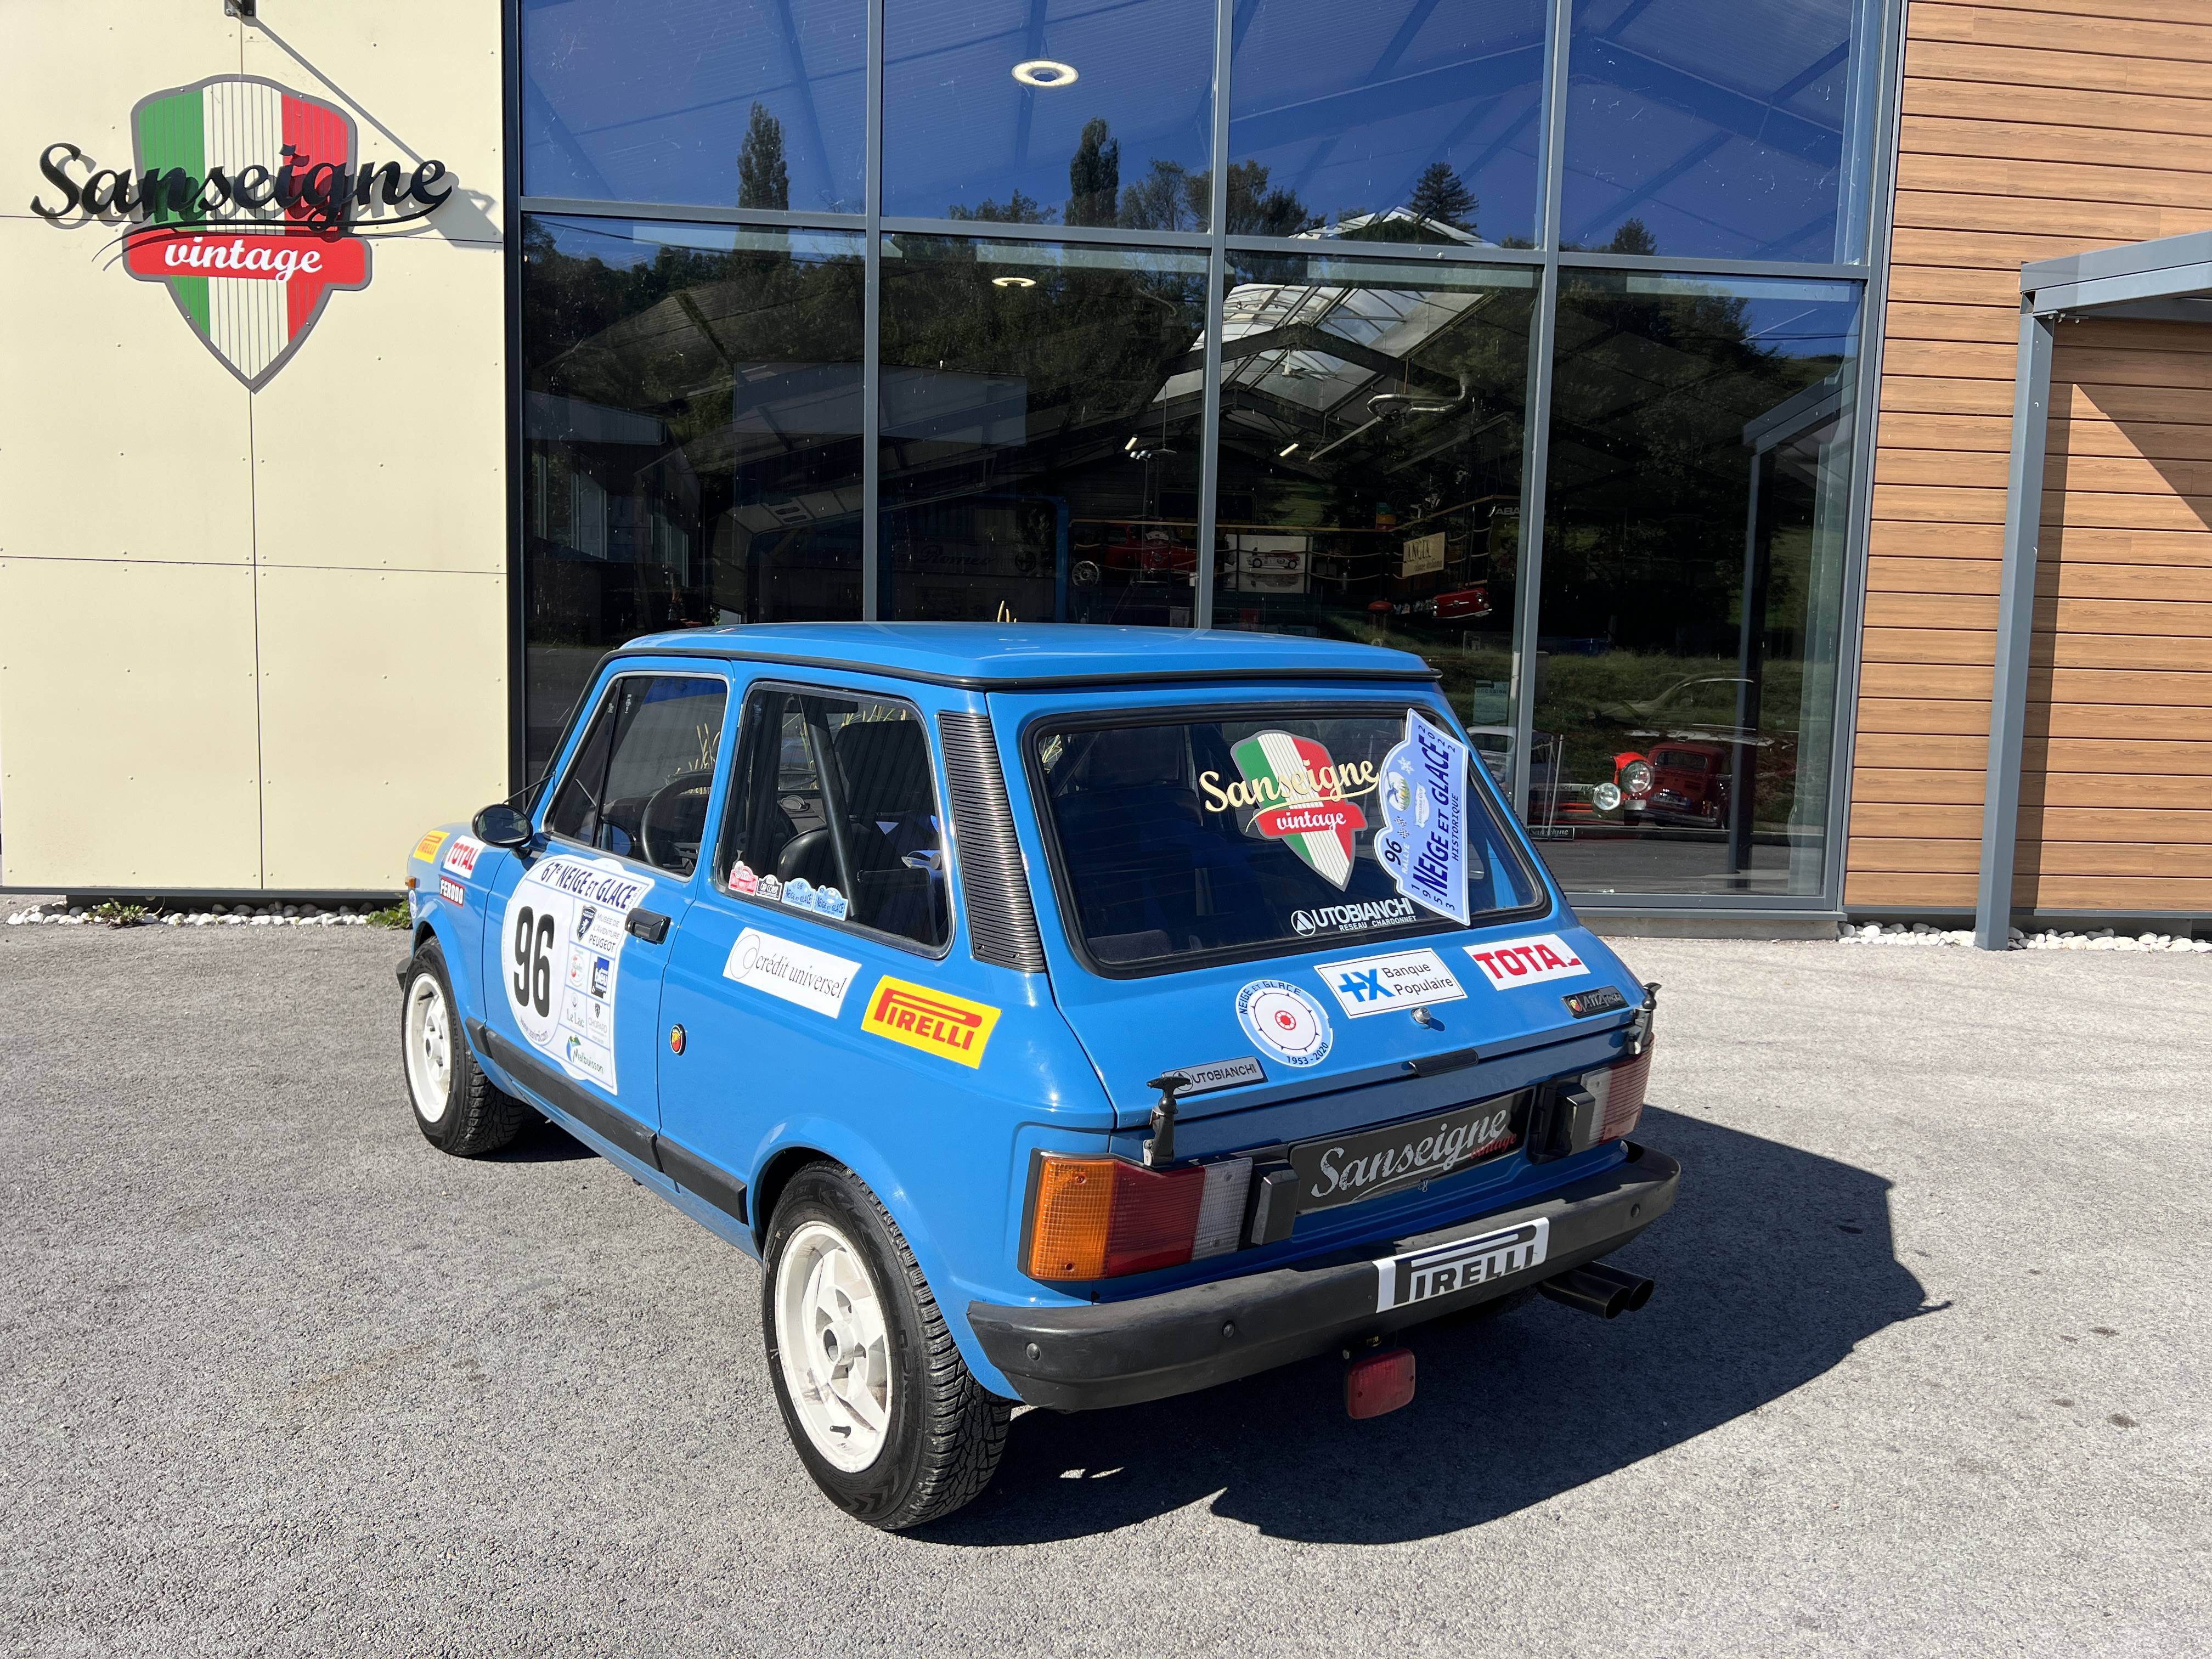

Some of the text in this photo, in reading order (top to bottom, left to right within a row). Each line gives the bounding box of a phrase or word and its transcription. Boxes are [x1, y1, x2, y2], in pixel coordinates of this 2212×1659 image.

[30, 143, 452, 233] Sanseigne
[165, 237, 322, 281] vintage
[1200, 759, 1379, 812] Sanseigne
[1277, 810, 1346, 831] vintage
[1413, 734, 1449, 897] NEIGE ET GLACE
[1451, 793, 1460, 861] HISTORIQUE
[447, 842, 478, 871] TOTAL
[1384, 838, 1402, 866] 96
[1402, 843, 1410, 874] RALLYE
[440, 879, 464, 904] FERODO
[555, 865, 592, 895] NEIGE
[584, 880, 599, 898] ET
[596, 878, 637, 909] GLACE
[593, 924, 620, 939] L'AVENTURE
[612, 919, 620, 927] DE
[1339, 916, 1417, 932] RESEAU CHARDONNET
[589, 934, 616, 952] PEUGEOT
[514, 906, 555, 1018] 96
[755, 955, 847, 998] crédit universel
[1381, 963, 1432, 979] Banque
[595, 968, 608, 986] bleu
[1393, 977, 1454, 996] Populaire
[1238, 988, 1252, 1015] NEIGE
[1262, 981, 1302, 996] GLACE
[567, 1008, 584, 1028] Le Lac
[874, 988, 982, 1051] PIRELLI
[573, 1048, 604, 1075] Malbuisson
[1286, 1056, 1309, 1065] 1953
[1313, 1042, 1329, 1060] 2020
[1311, 1110, 1506, 1197] Sanseigne
[1393, 1224, 1537, 1306] PIRELLI
